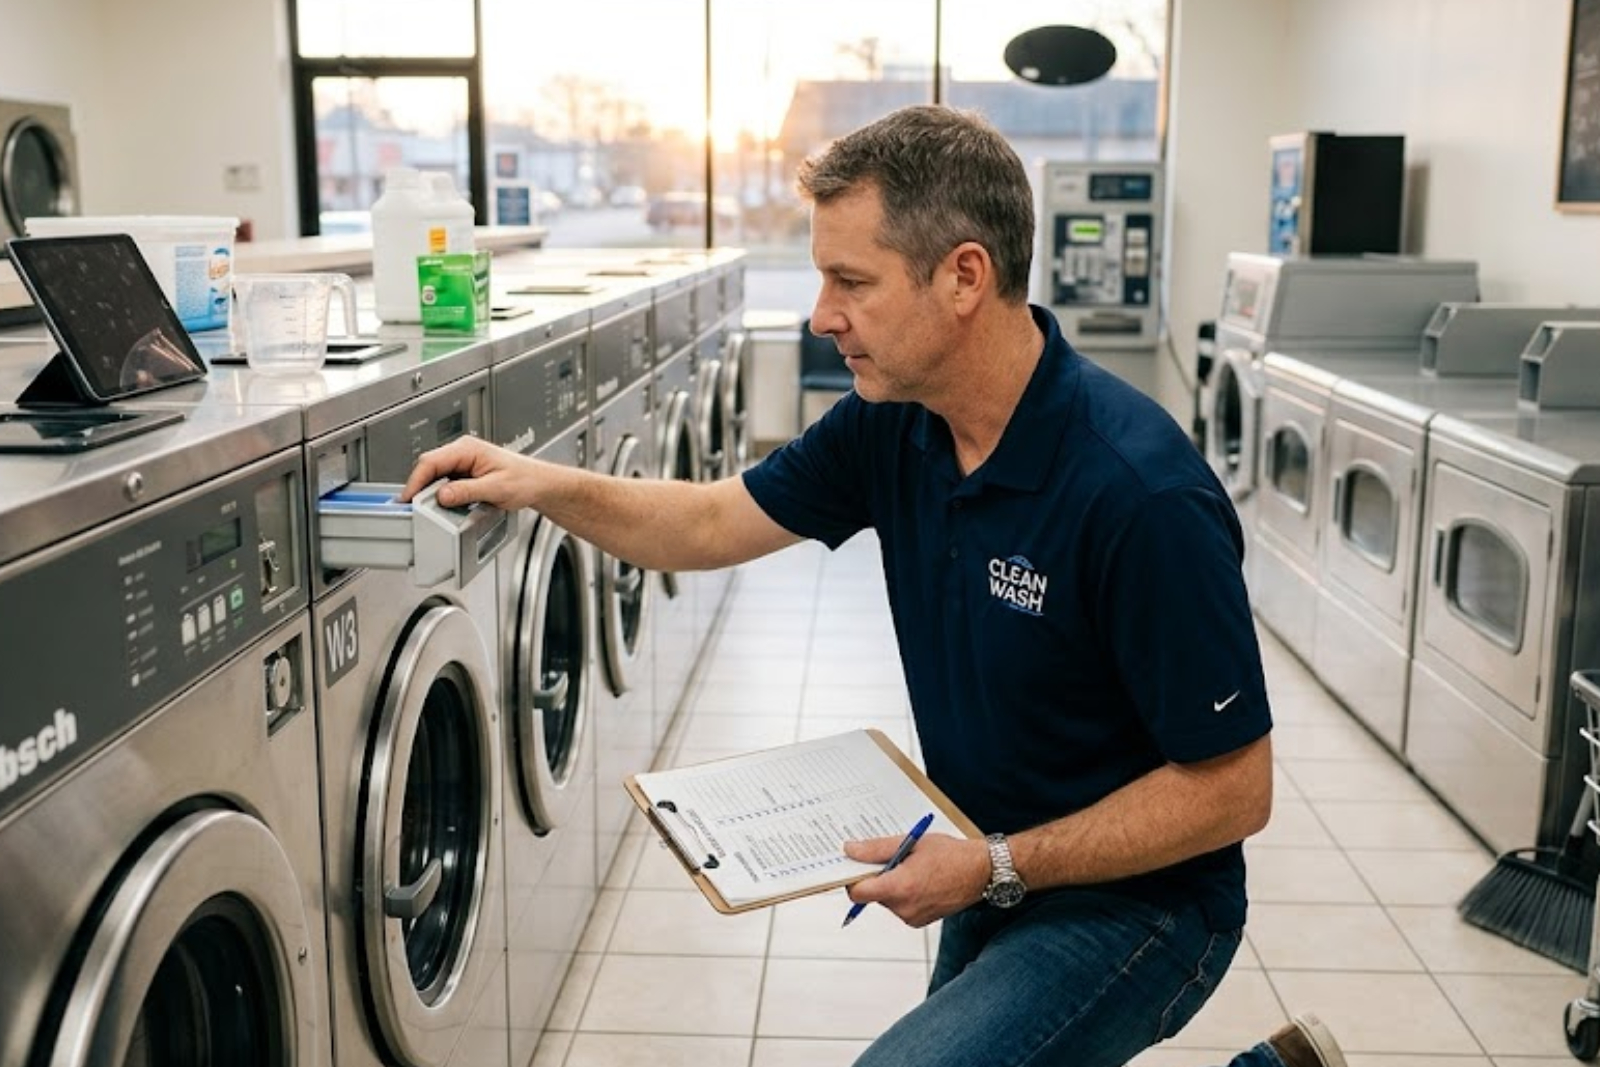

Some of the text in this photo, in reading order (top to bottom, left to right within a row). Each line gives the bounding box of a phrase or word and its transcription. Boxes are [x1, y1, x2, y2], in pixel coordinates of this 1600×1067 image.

[989, 558, 1047, 594] CLEAN
[989, 576, 1043, 612] WASH
[326, 609, 357, 672] W3
